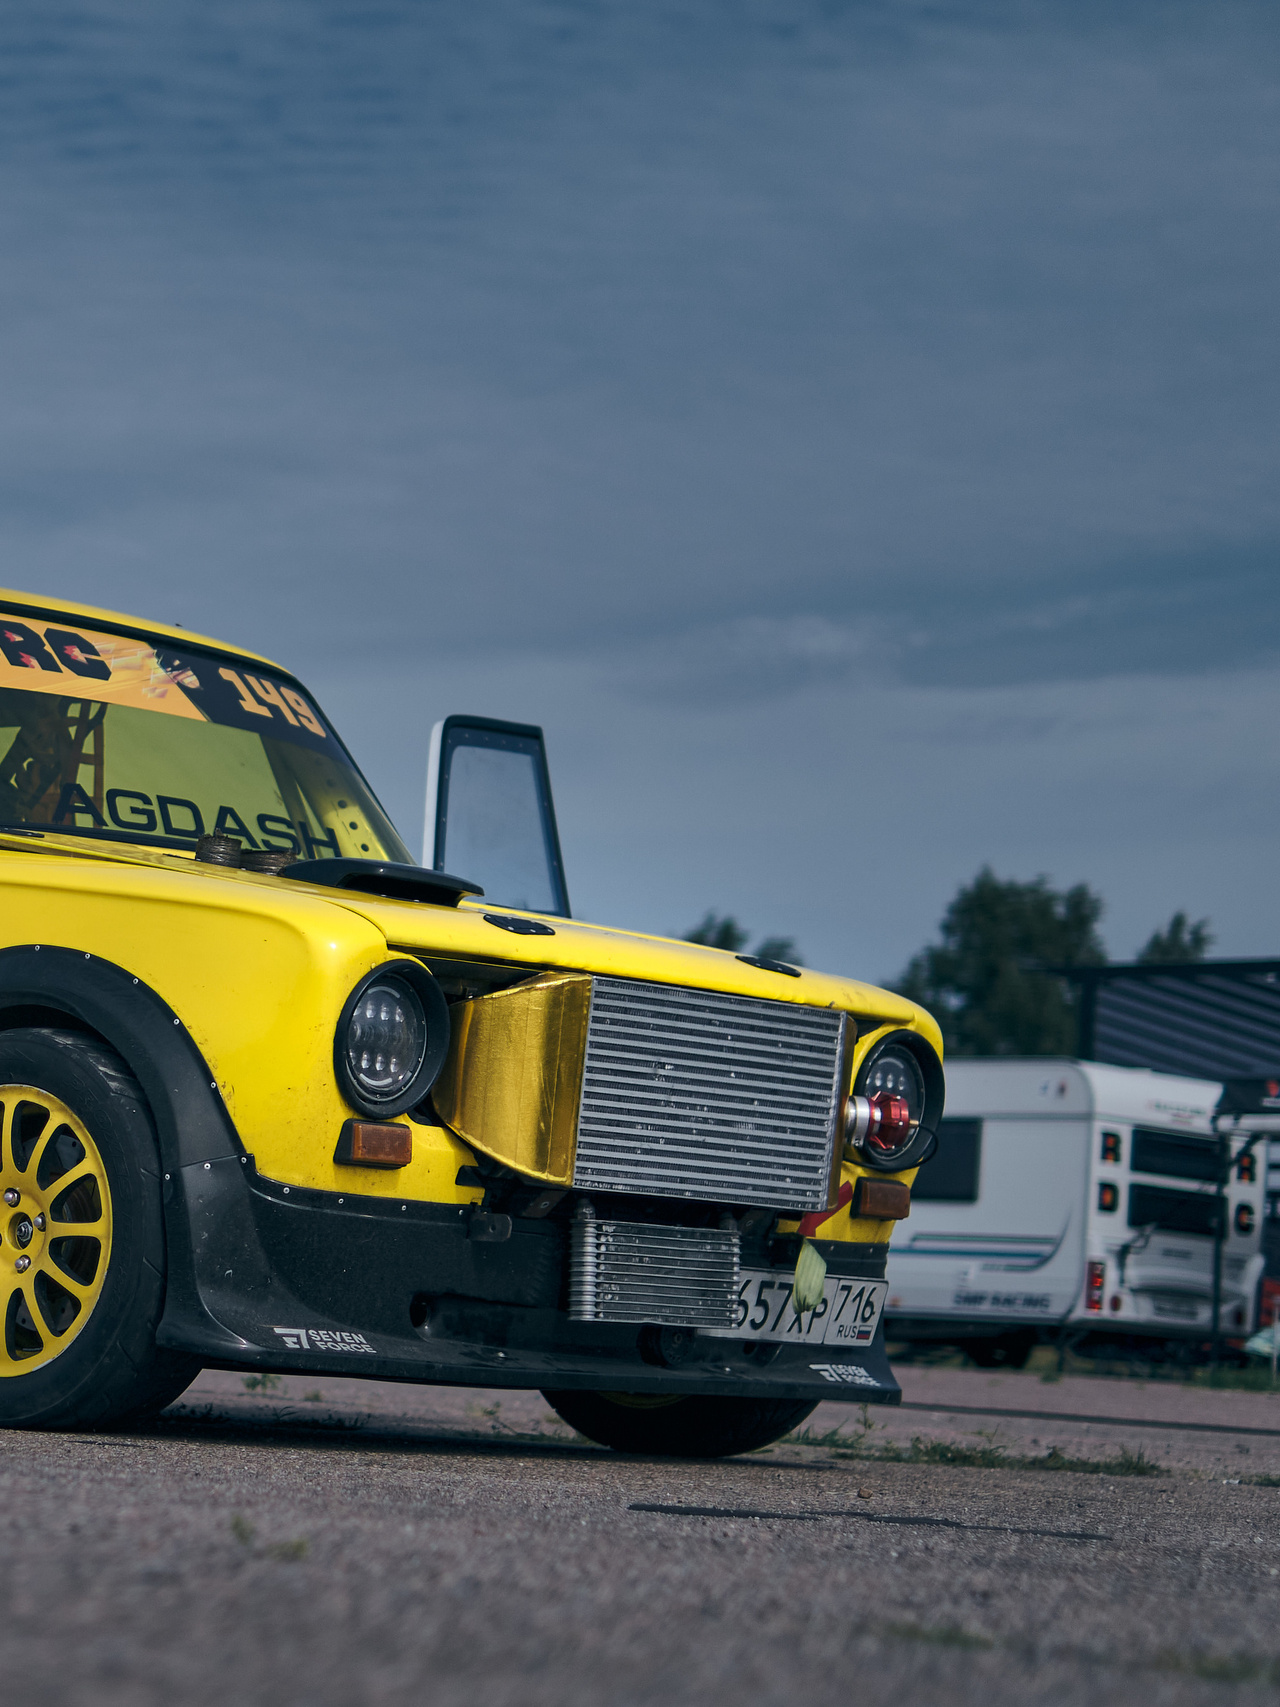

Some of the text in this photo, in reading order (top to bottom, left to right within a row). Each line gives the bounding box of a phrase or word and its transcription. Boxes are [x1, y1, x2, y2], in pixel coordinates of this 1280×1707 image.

[218, 666, 327, 738] 149
[52, 783, 342, 860] AGDASH
[834, 1284, 877, 1323] 716
[308, 1329, 367, 1344] SEVEN
[837, 1325, 857, 1338] RUS
[315, 1341, 377, 1353] FORCE
